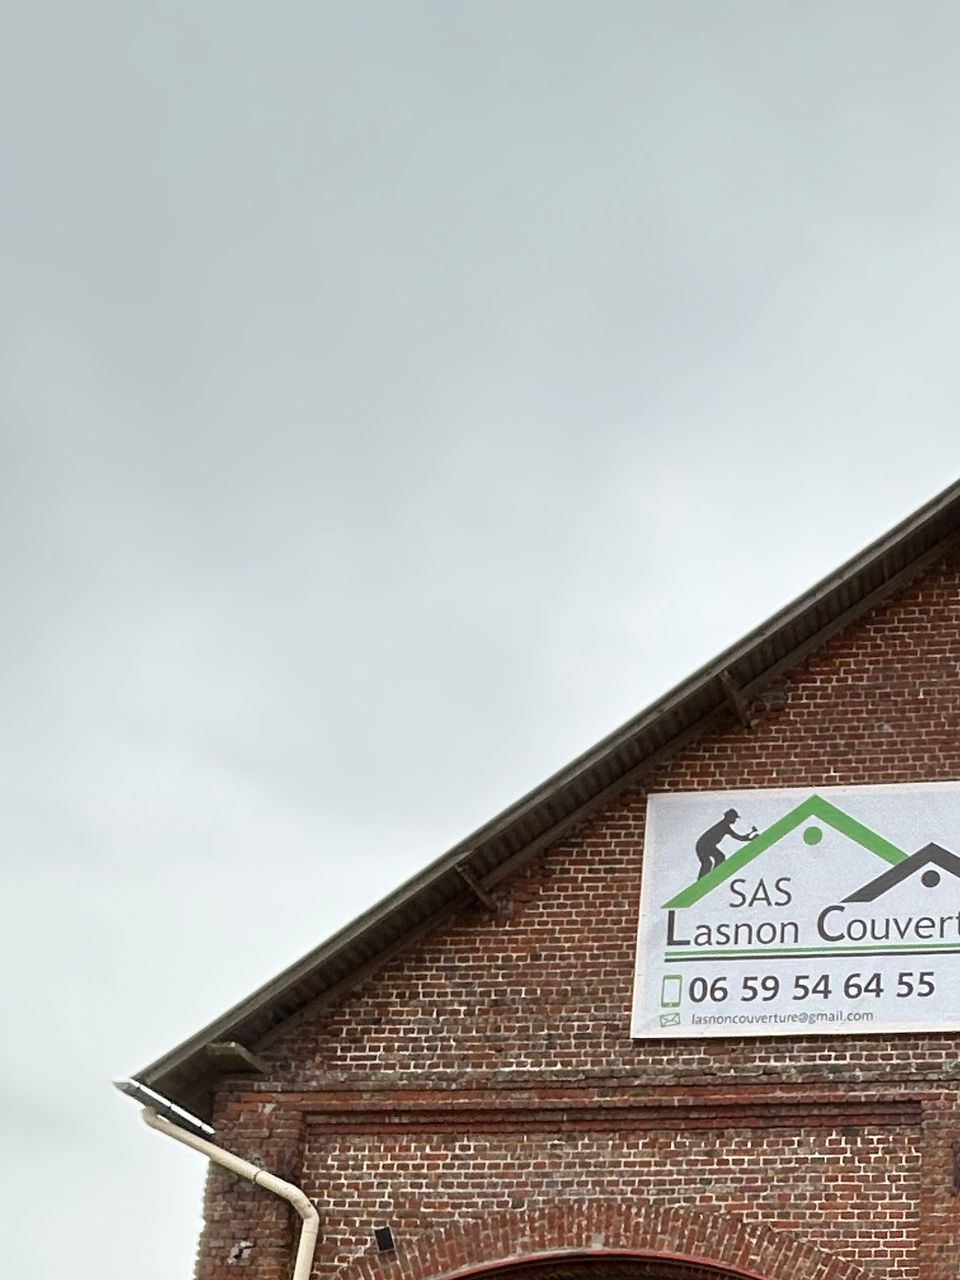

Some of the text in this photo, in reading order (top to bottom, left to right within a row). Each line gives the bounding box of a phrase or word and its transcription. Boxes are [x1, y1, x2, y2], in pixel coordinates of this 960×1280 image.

[729, 877, 792, 908] SAS
[666, 909, 799, 947] Lasnon
[689, 971, 935, 1002] 06 59 54 64 55
[692, 1011, 873, 1026] lasnoncouverture@gmail.com
